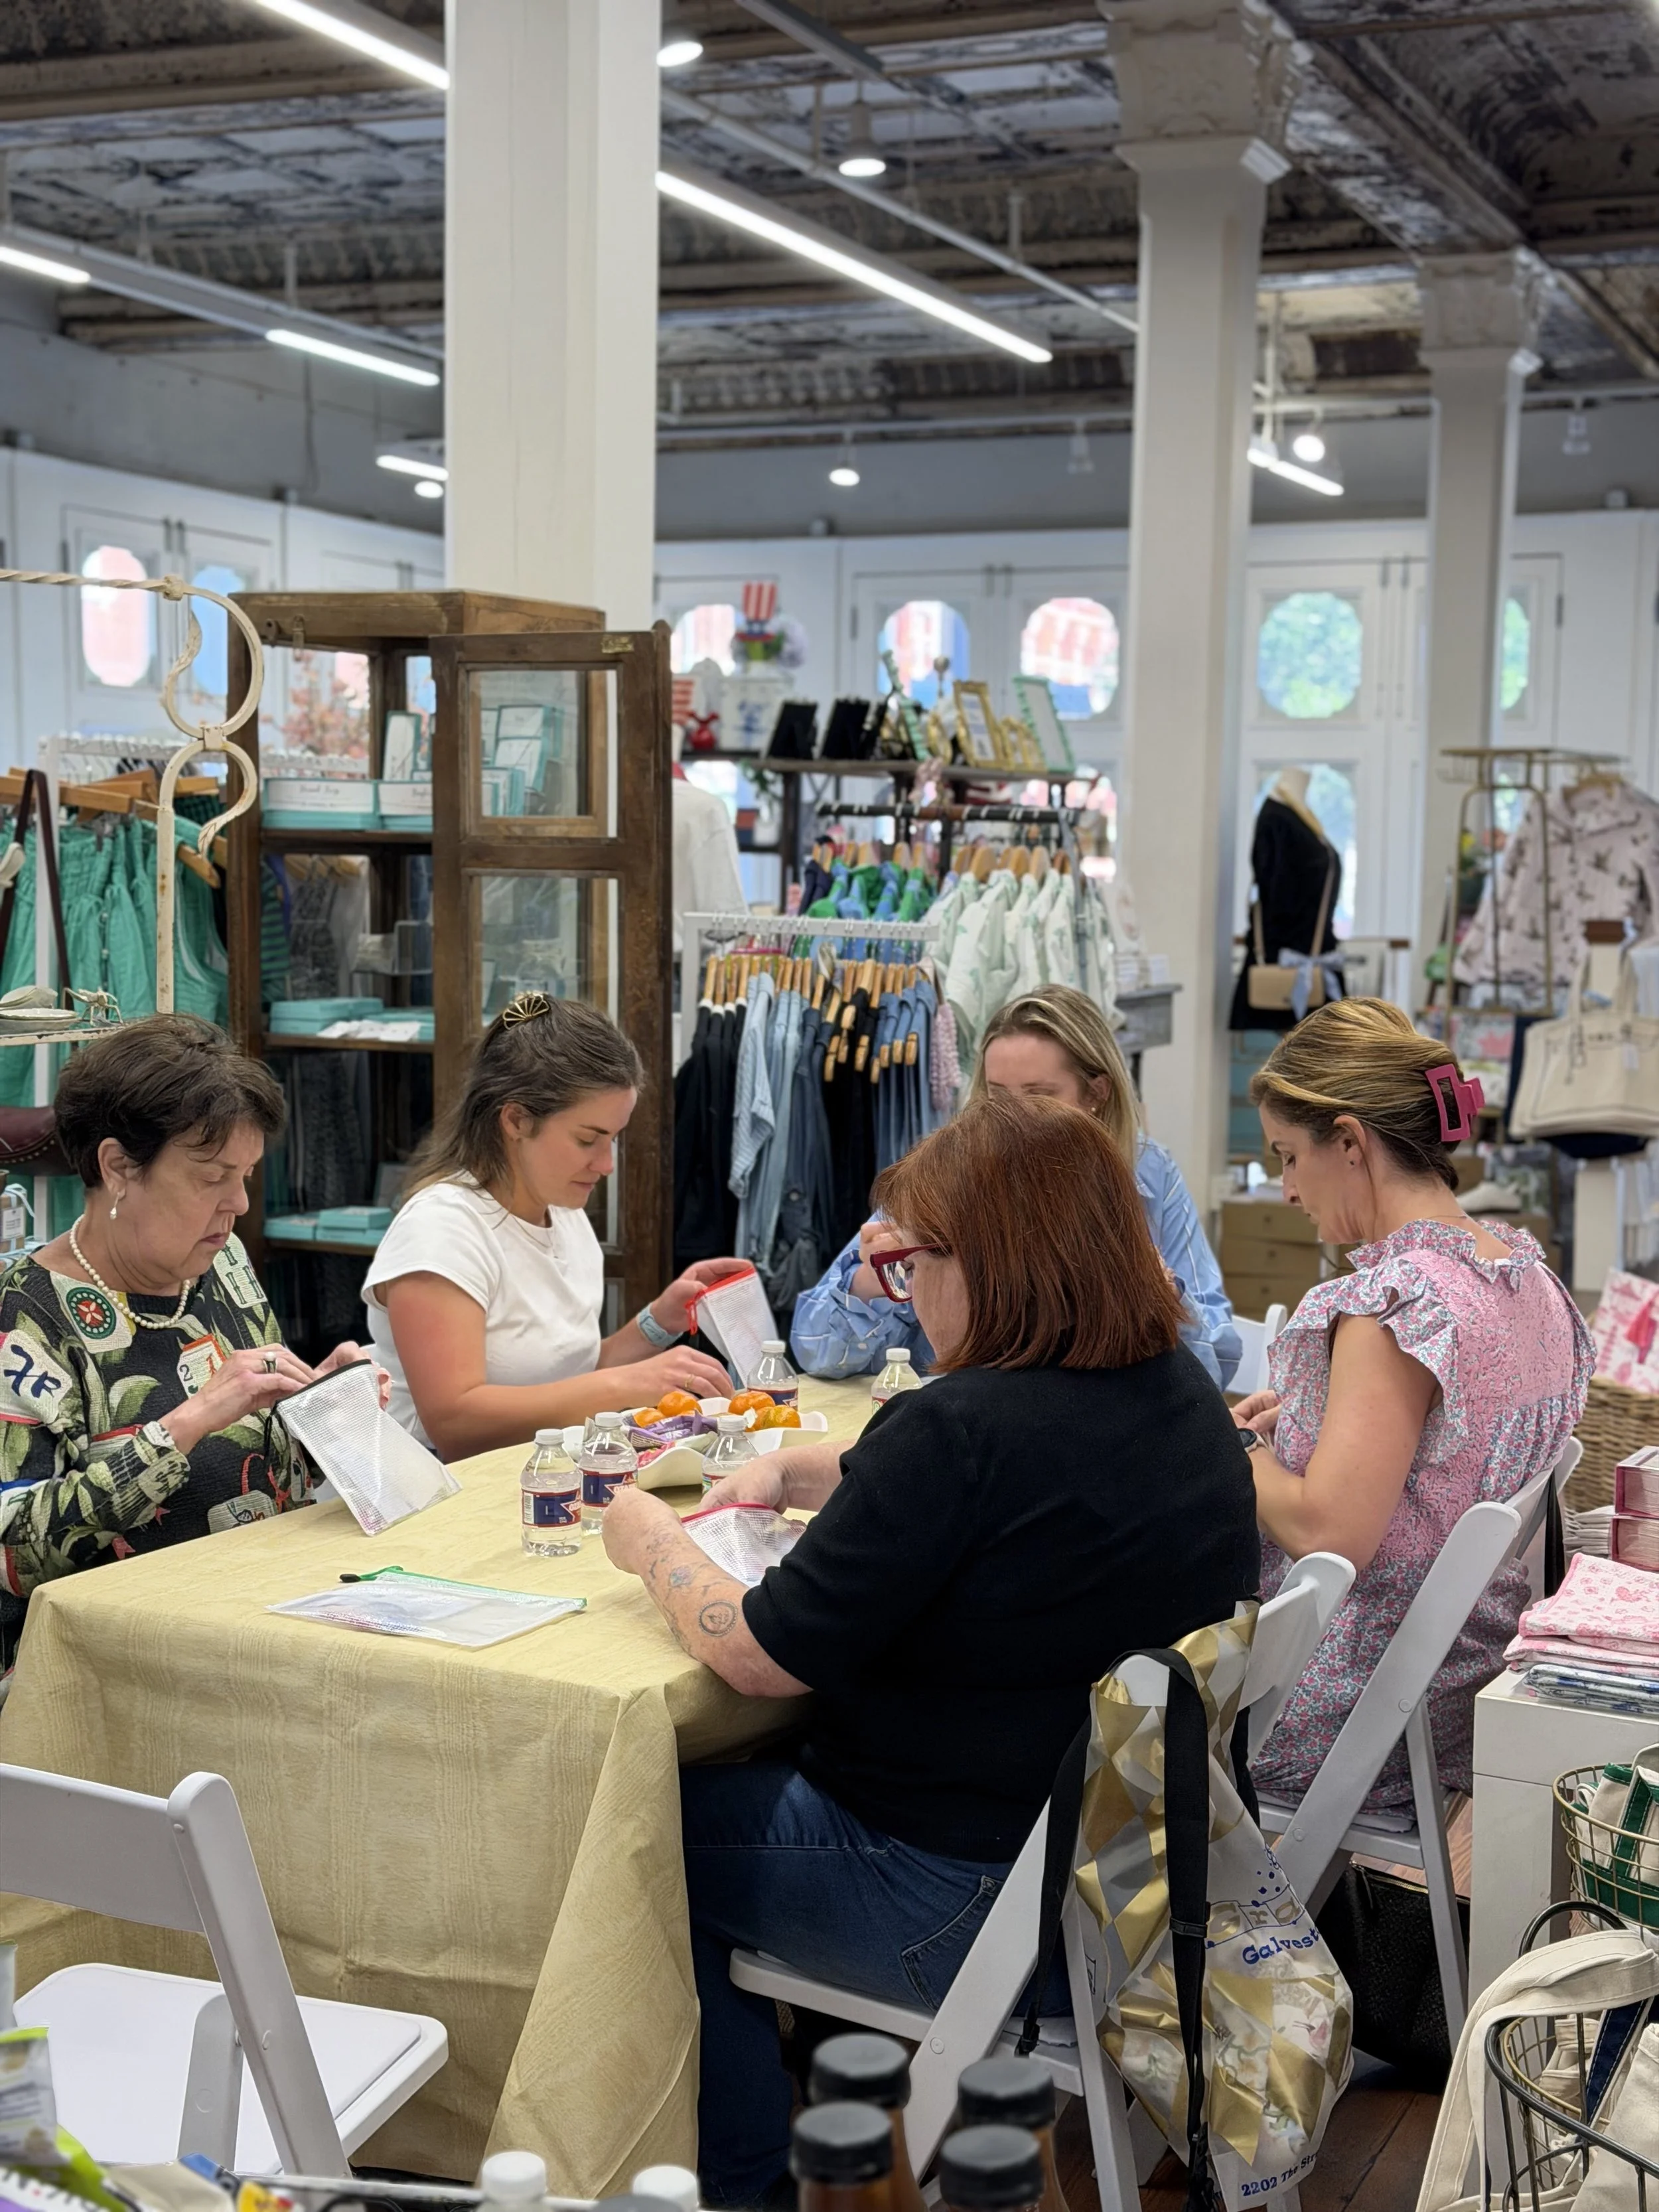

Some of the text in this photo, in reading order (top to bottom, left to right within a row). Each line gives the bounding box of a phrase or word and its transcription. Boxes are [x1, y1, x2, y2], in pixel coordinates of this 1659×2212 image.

[179, 1364, 193, 1382] 2
[1241, 2176, 1277, 2197] 2202
[1281, 2166, 1298, 2183] The
